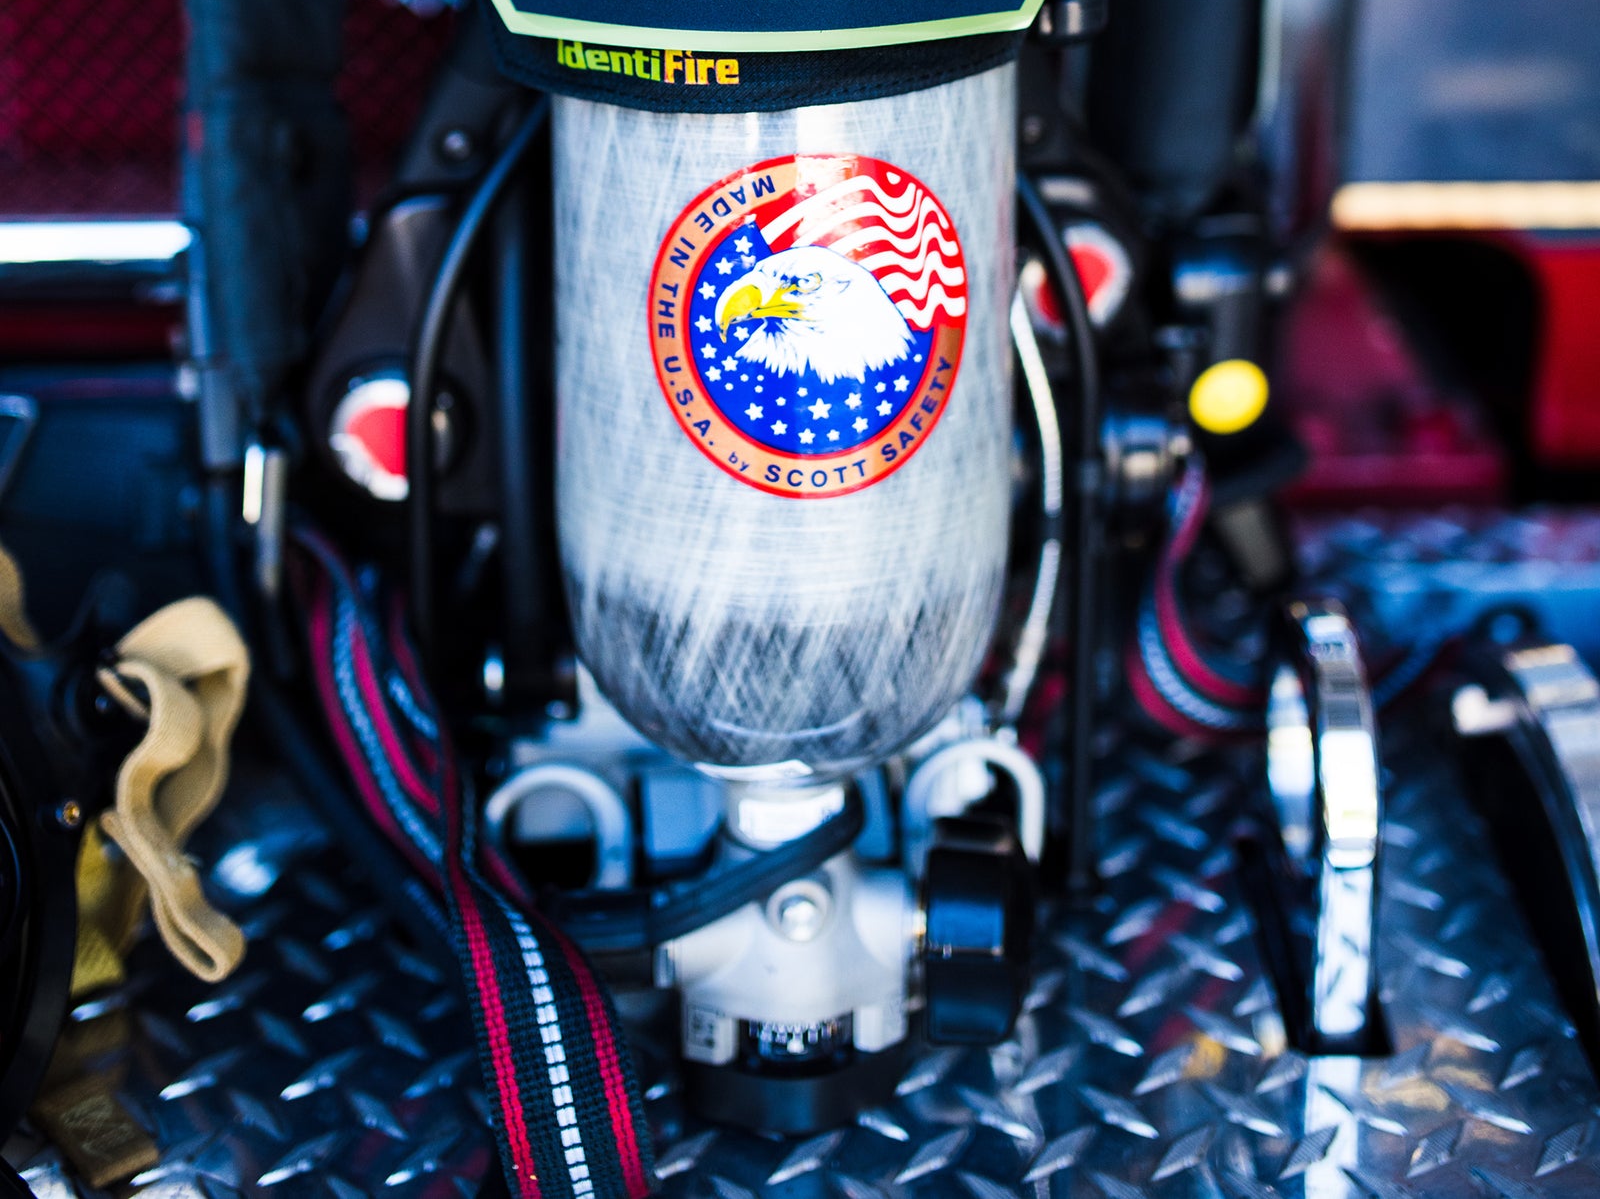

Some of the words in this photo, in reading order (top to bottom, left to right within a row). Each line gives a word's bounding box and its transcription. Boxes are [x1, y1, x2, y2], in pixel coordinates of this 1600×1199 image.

[694, 175, 776, 233] MADE
[669, 236, 697, 269] IN
[658, 282, 680, 339] THE
[663, 356, 715, 447] U.S.A.
[880, 357, 953, 462] SAFETY
[728, 452, 750, 473] by
[764, 459, 868, 488] SCOTT
